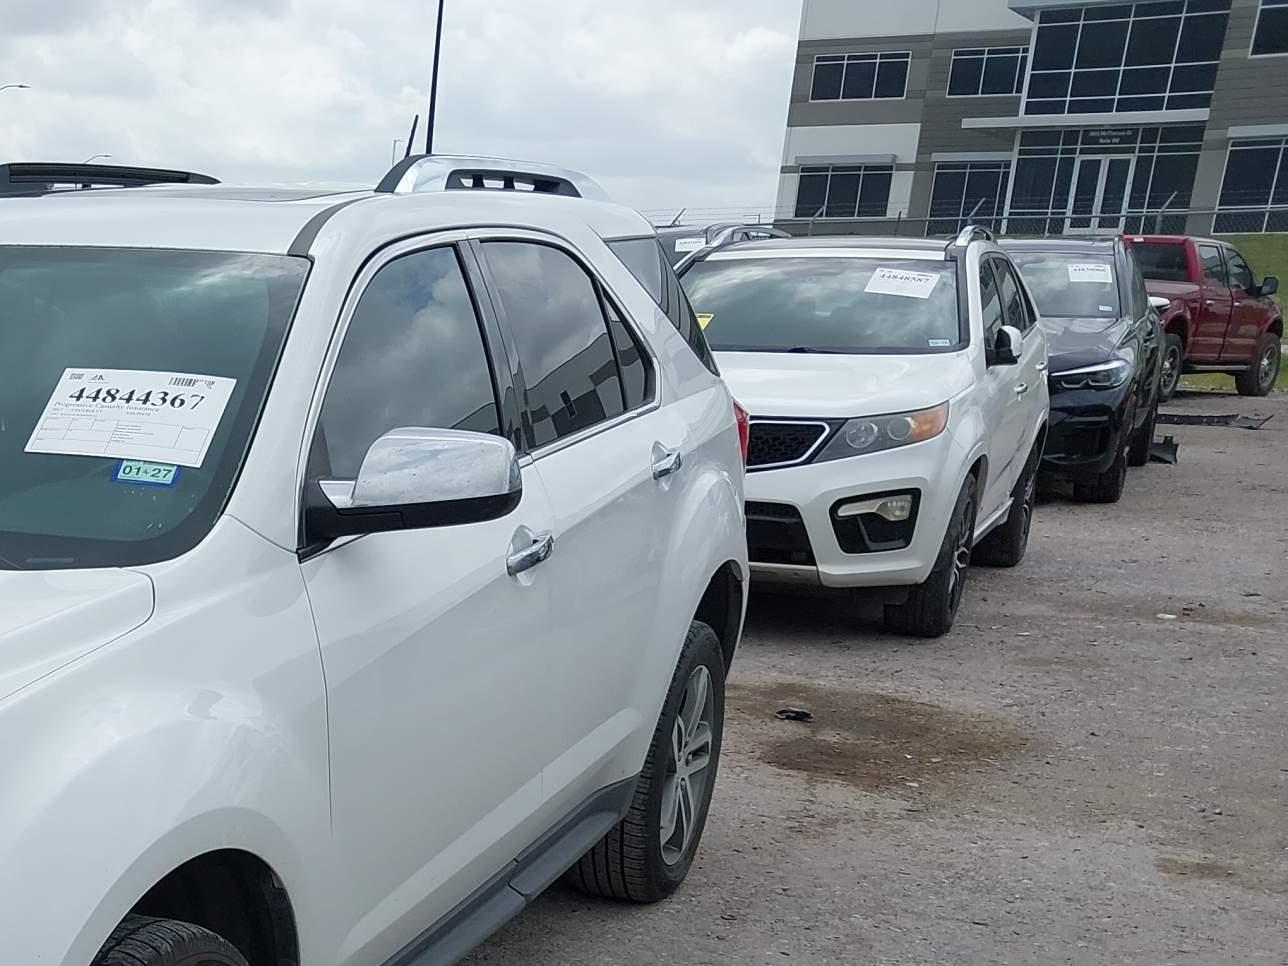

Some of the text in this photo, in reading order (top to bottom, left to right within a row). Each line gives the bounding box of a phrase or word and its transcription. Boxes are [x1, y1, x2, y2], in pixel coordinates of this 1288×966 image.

[68, 386, 206, 411] 44844367
[122, 465, 173, 479] 01 27
